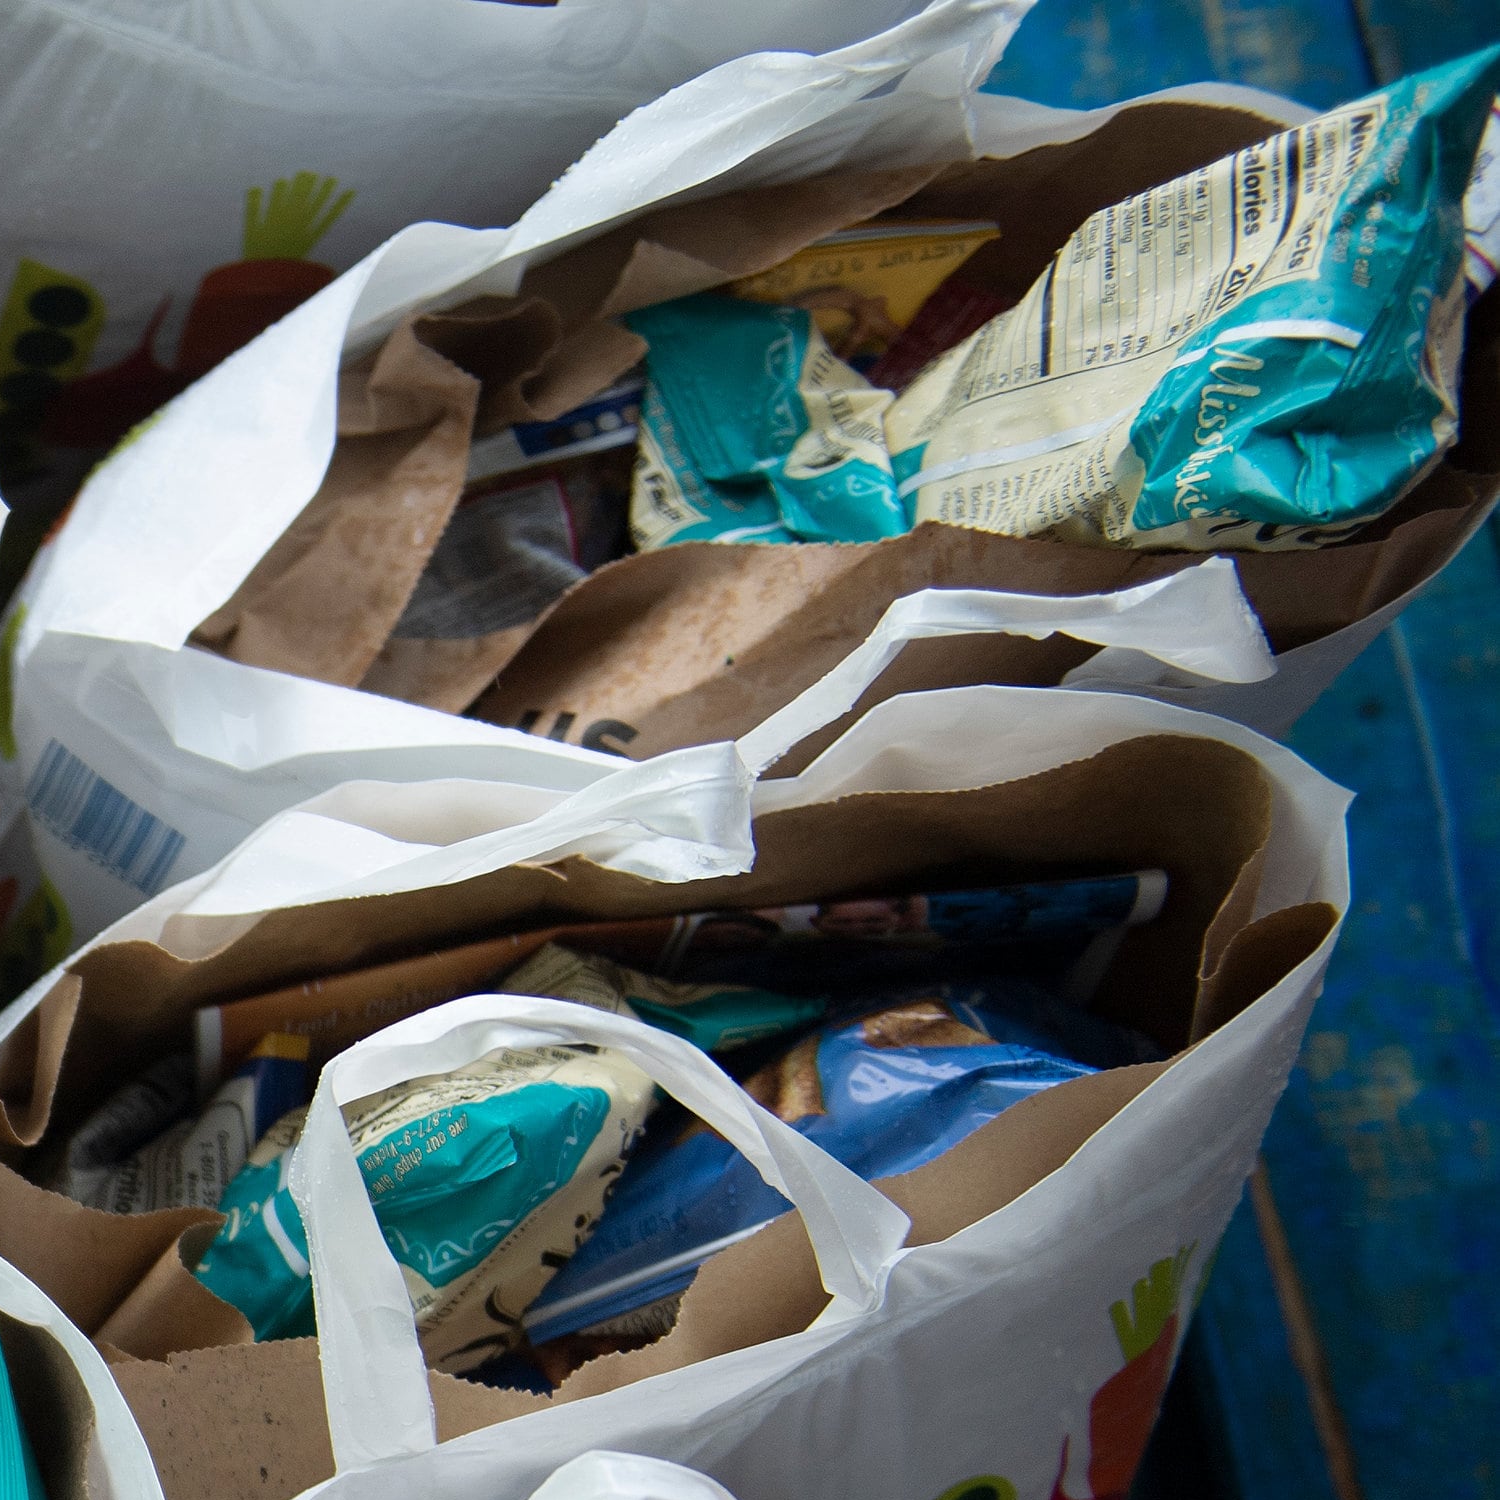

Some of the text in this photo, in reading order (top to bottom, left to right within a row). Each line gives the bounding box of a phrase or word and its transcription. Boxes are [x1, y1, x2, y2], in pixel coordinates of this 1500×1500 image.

[1194, 347, 1264, 446] Miss
[364, 1110, 454, 1170] 1-877-9-Vickie
[391, 1113, 468, 1181] Love our chips?
